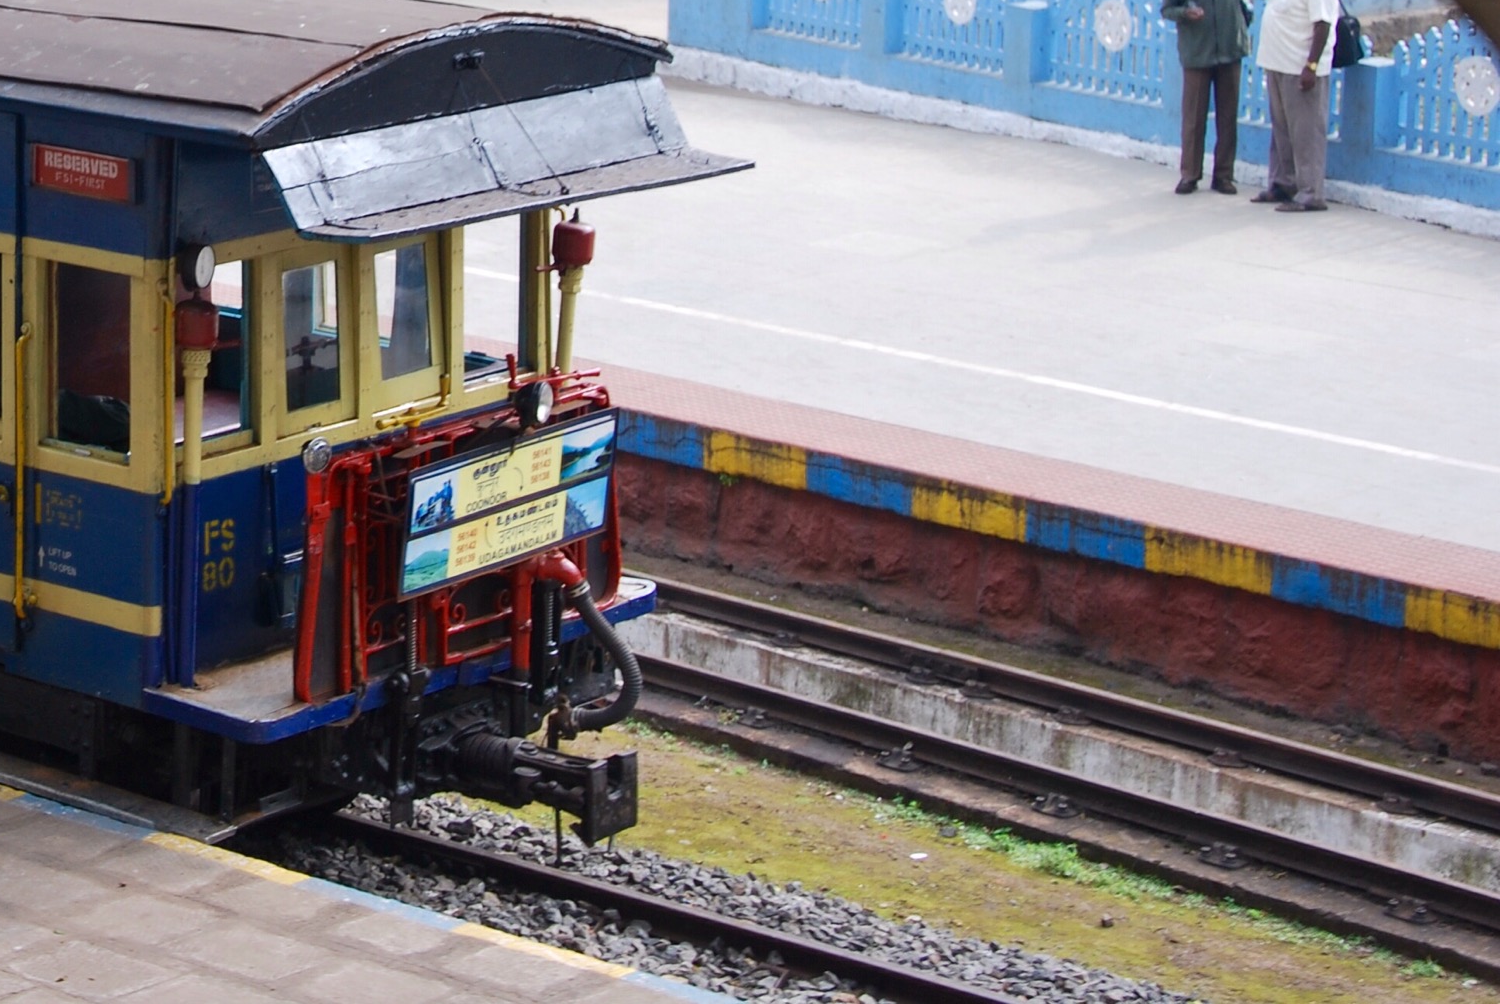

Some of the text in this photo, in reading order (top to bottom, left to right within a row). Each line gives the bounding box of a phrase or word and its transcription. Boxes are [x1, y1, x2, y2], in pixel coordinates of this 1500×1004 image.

[44, 150, 119, 179] RESERVED
[465, 491, 507, 513] COONOOR
[203, 518, 235, 556] FS
[478, 530, 558, 565] UDAGAMANDALAM
[47, 547, 73, 560] LIFT UP
[58, 563, 77, 577] OPEN
[203, 556, 235, 592] 80
